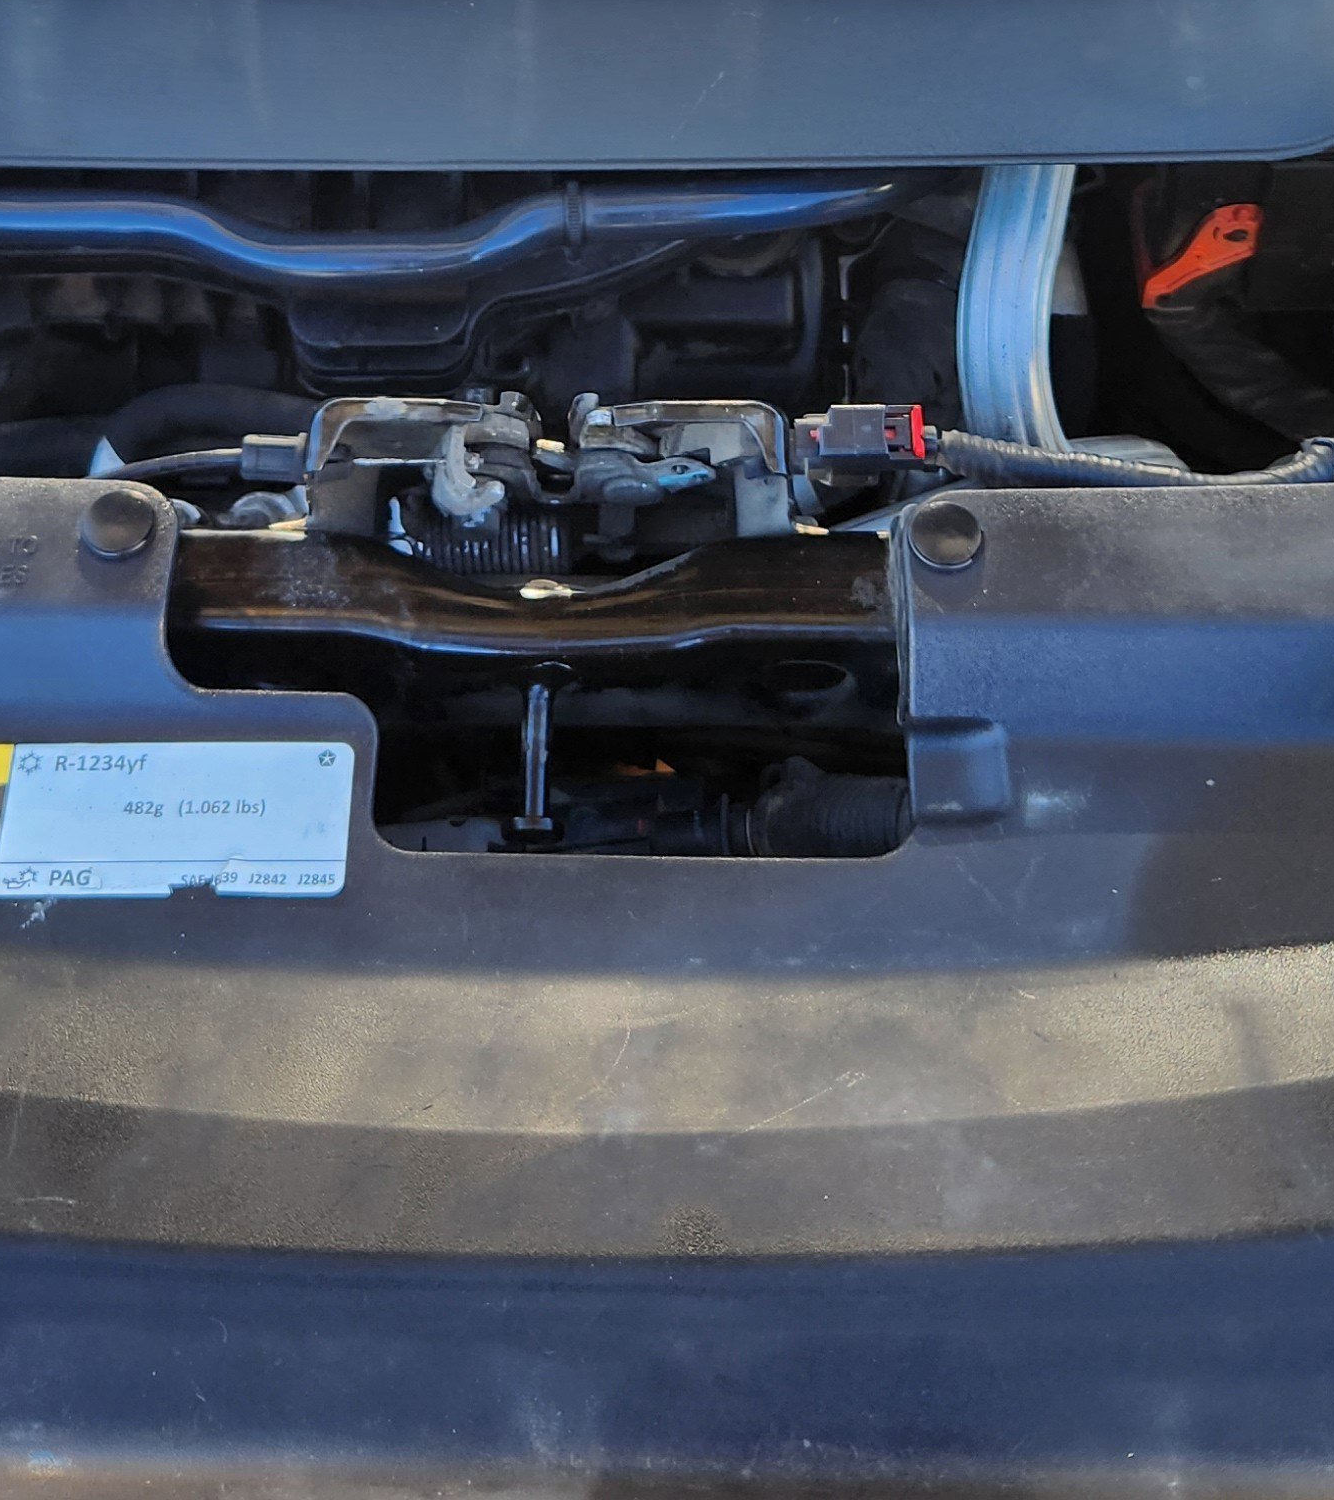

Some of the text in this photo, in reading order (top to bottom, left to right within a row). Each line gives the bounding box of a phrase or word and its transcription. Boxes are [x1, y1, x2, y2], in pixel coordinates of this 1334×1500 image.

[9, 534, 39, 556] TO
[54, 754, 148, 775] R-1234yf
[123, 799, 266, 818] 482g (1.062 lbs)
[48, 869, 91, 887] PAG
[248, 873, 287, 885] J2842
[297, 873, 335, 885] J2845
